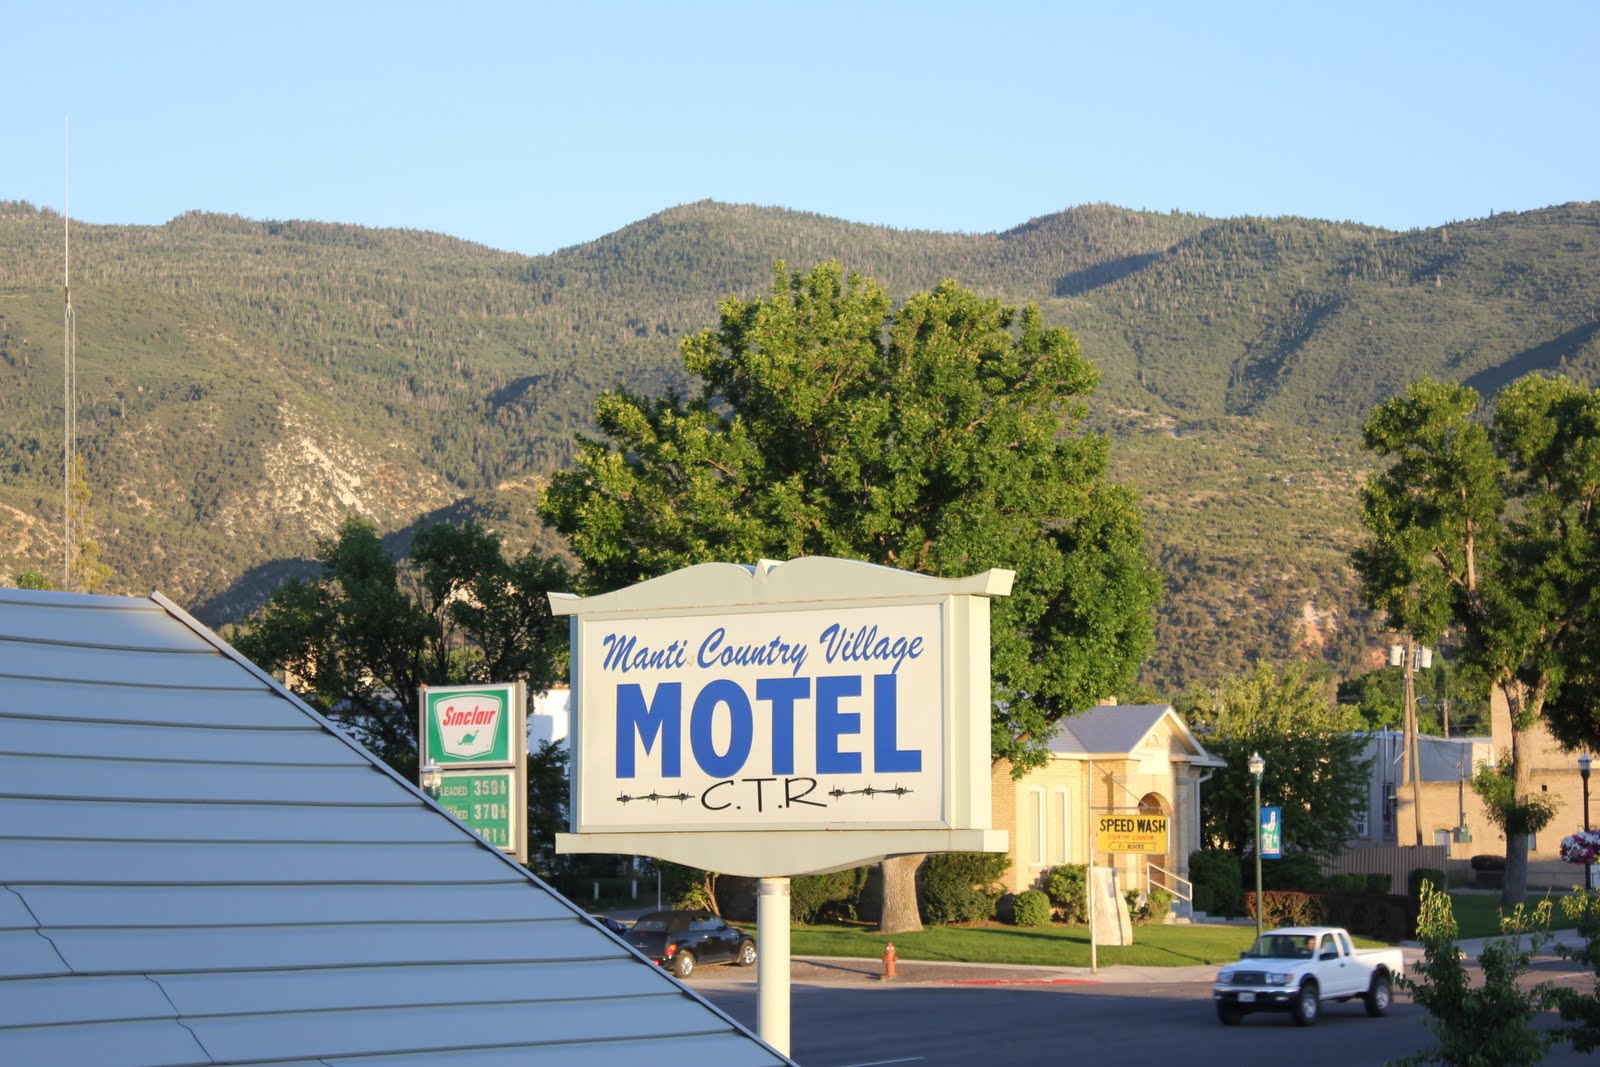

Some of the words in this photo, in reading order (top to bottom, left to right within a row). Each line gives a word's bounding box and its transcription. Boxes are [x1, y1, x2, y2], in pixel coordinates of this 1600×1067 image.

[603, 633, 688, 673] Manti
[697, 627, 809, 677] Country
[819, 623, 924, 674] Village
[443, 705, 497, 726] Sinclair
[615, 674, 922, 779] MOTEL
[440, 786, 468, 797] LEADED
[700, 777, 828, 813] C.T.R
[1100, 818, 1135, 833] SPEED
[1137, 819, 1166, 833] WASH
